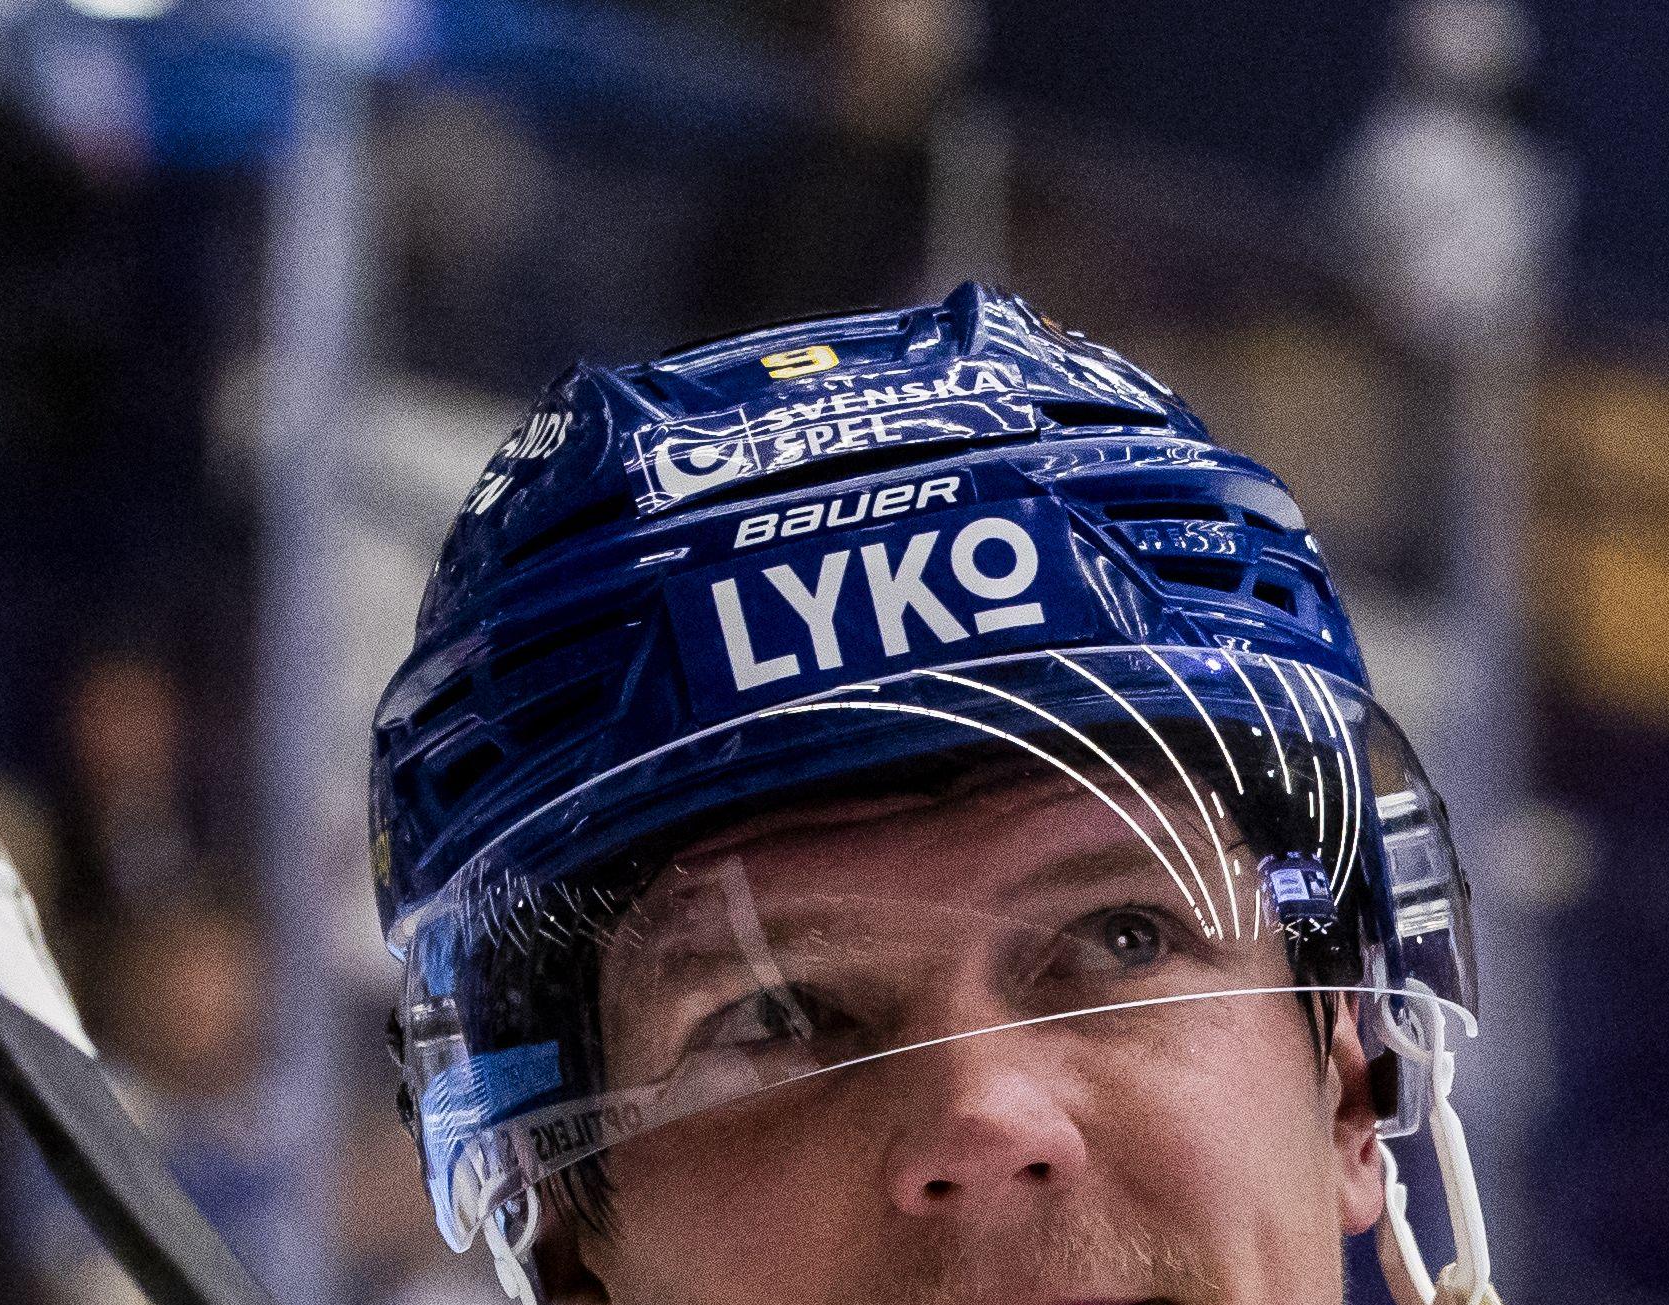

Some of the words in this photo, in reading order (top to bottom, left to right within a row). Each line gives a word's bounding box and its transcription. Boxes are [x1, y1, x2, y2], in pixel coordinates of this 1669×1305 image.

[760, 345, 840, 379] 9
[764, 370, 1009, 432] SVENSKA
[774, 412, 902, 462] SPEL
[733, 476, 960, 549] BAUER
[711, 517, 1045, 691] LYKO
